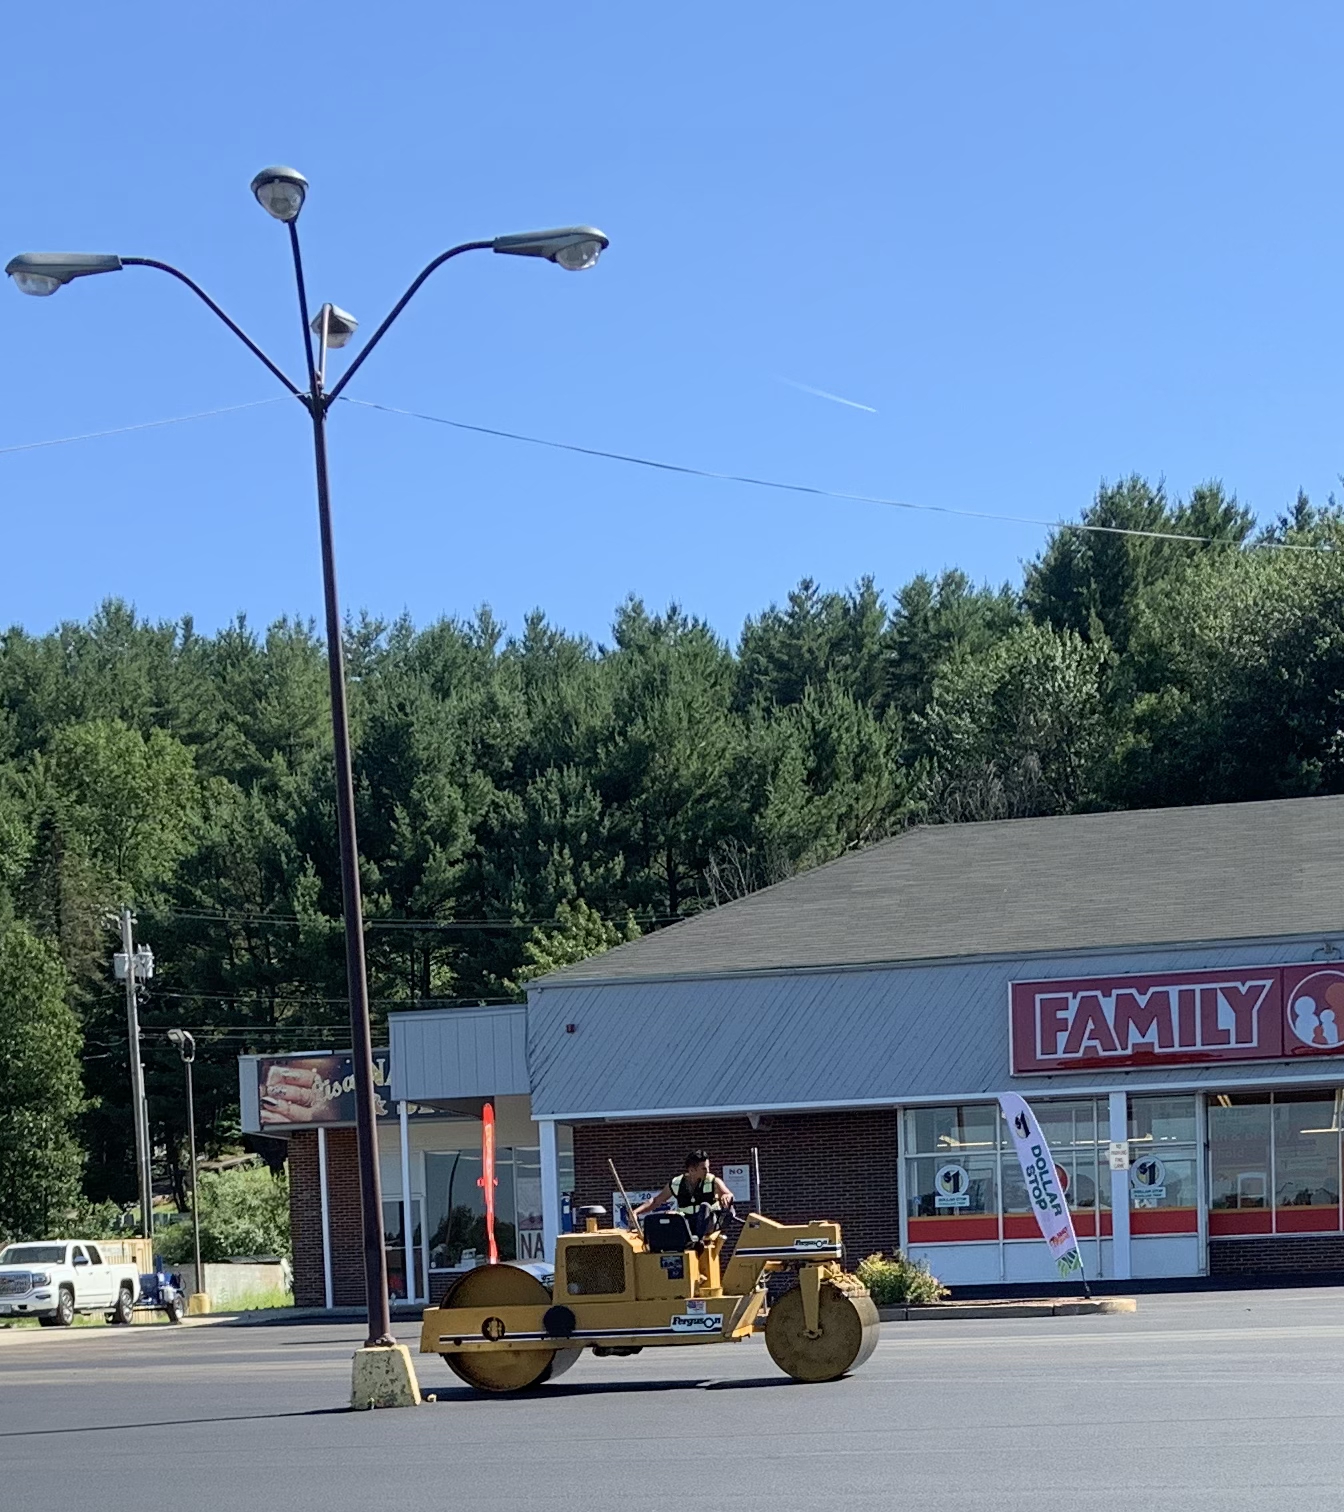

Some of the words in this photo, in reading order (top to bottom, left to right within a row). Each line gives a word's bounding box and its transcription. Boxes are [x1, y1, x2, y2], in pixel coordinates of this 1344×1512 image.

[1036, 980, 1277, 1060] FAMILY
[943, 1170, 960, 1194] $1
[1026, 1164, 1047, 1210] STOP
[1031, 1144, 1062, 1216] DOLLAR
[1138, 1161, 1156, 1186] $1
[672, 1316, 723, 1330] Ferguson
